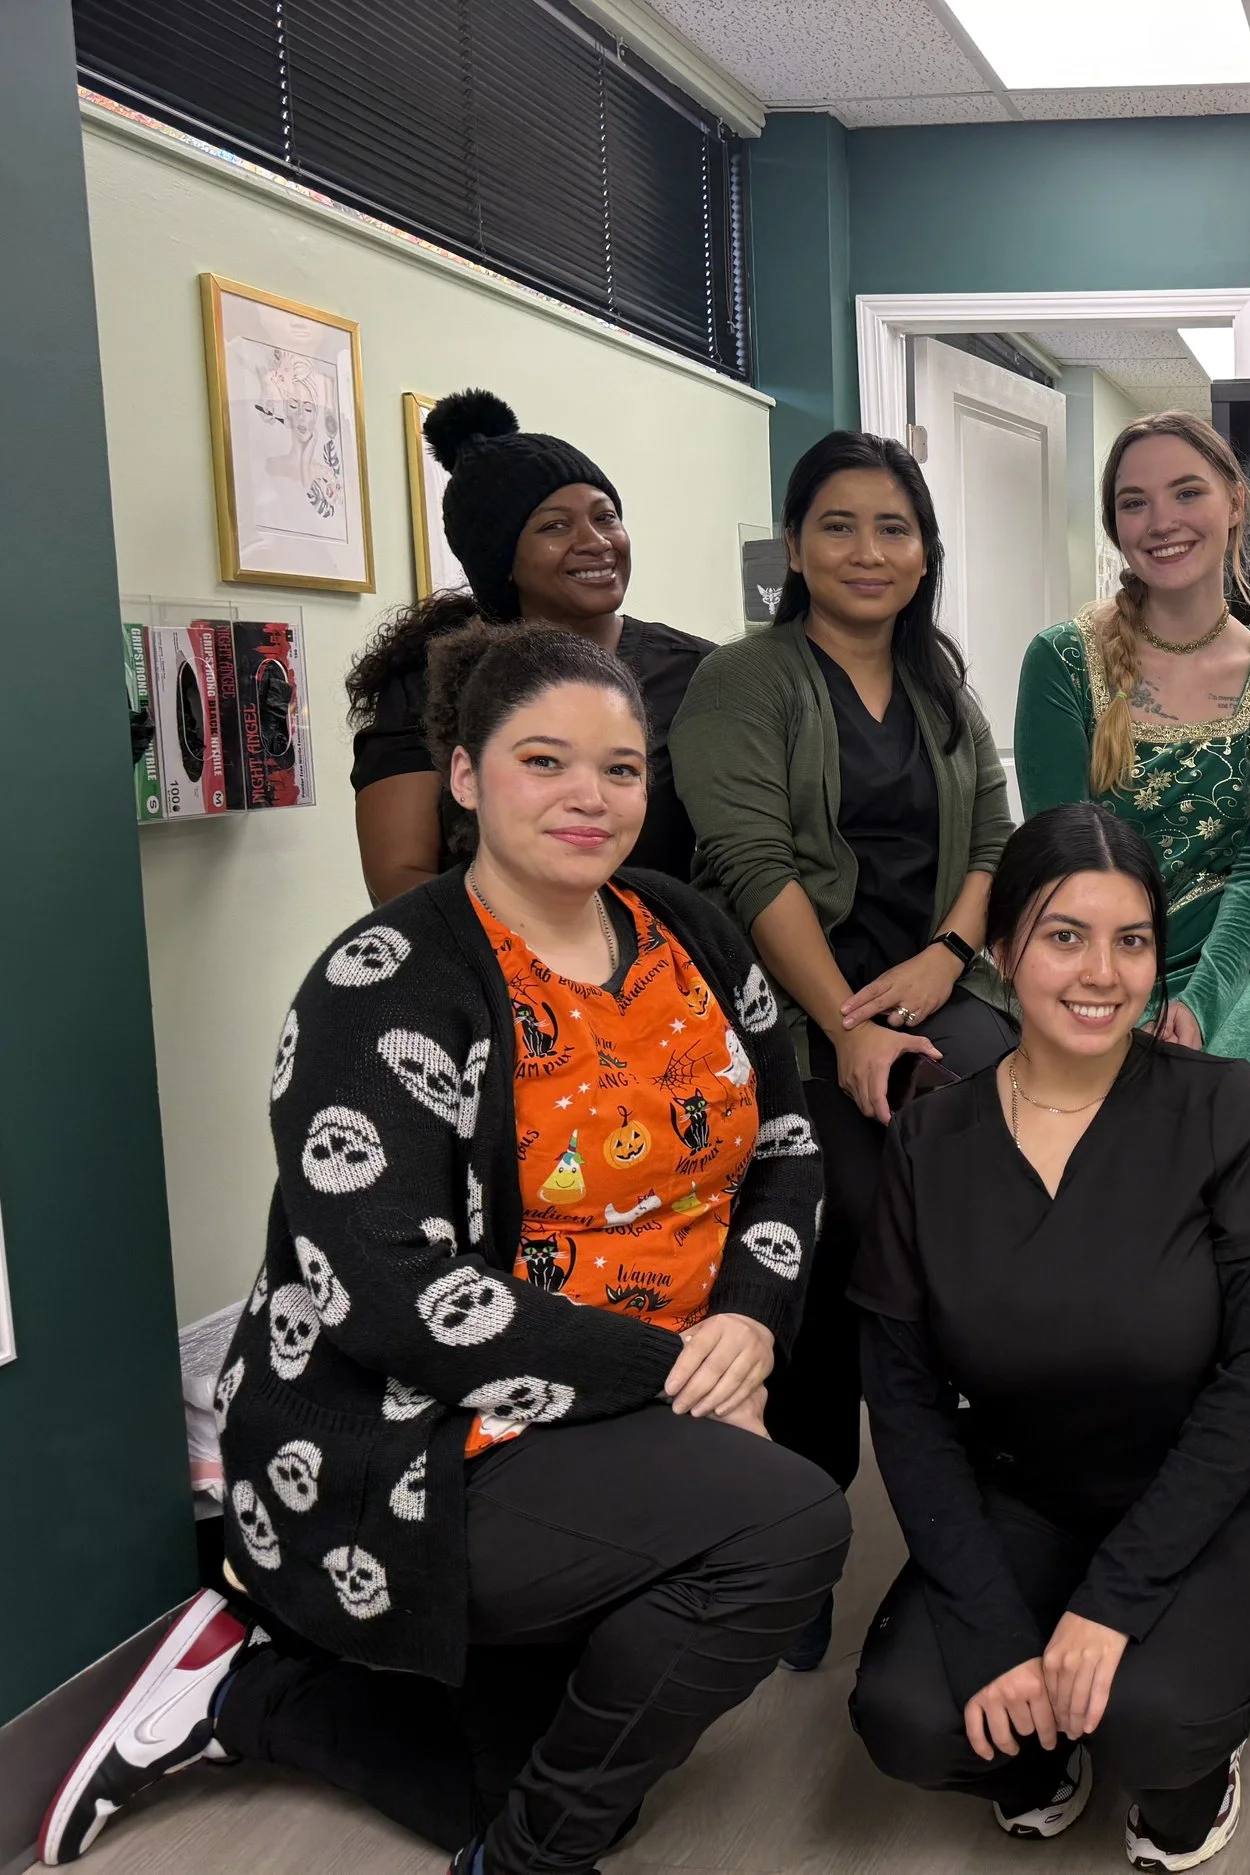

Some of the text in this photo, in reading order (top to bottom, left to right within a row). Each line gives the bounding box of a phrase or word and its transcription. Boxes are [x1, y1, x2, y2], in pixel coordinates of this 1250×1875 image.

[131, 628, 147, 696] GRIPSTRONG
[217, 625, 236, 699] NIGHT ANGEL
[202, 633, 223, 777] GRIPSTRONG BLACK NITRILE
[145, 742, 157, 781] ITRILE
[243, 703, 265, 804] NIGHT ANGEL
[170, 780, 181, 804] 100
[215, 793, 222, 804] M
[149, 800, 157, 809] S
[530, 958, 551, 983] Fab
[598, 1071, 640, 1090] ANG?
[524, 1205, 596, 1227] ndicorn
[617, 1263, 673, 1287] Wanna
